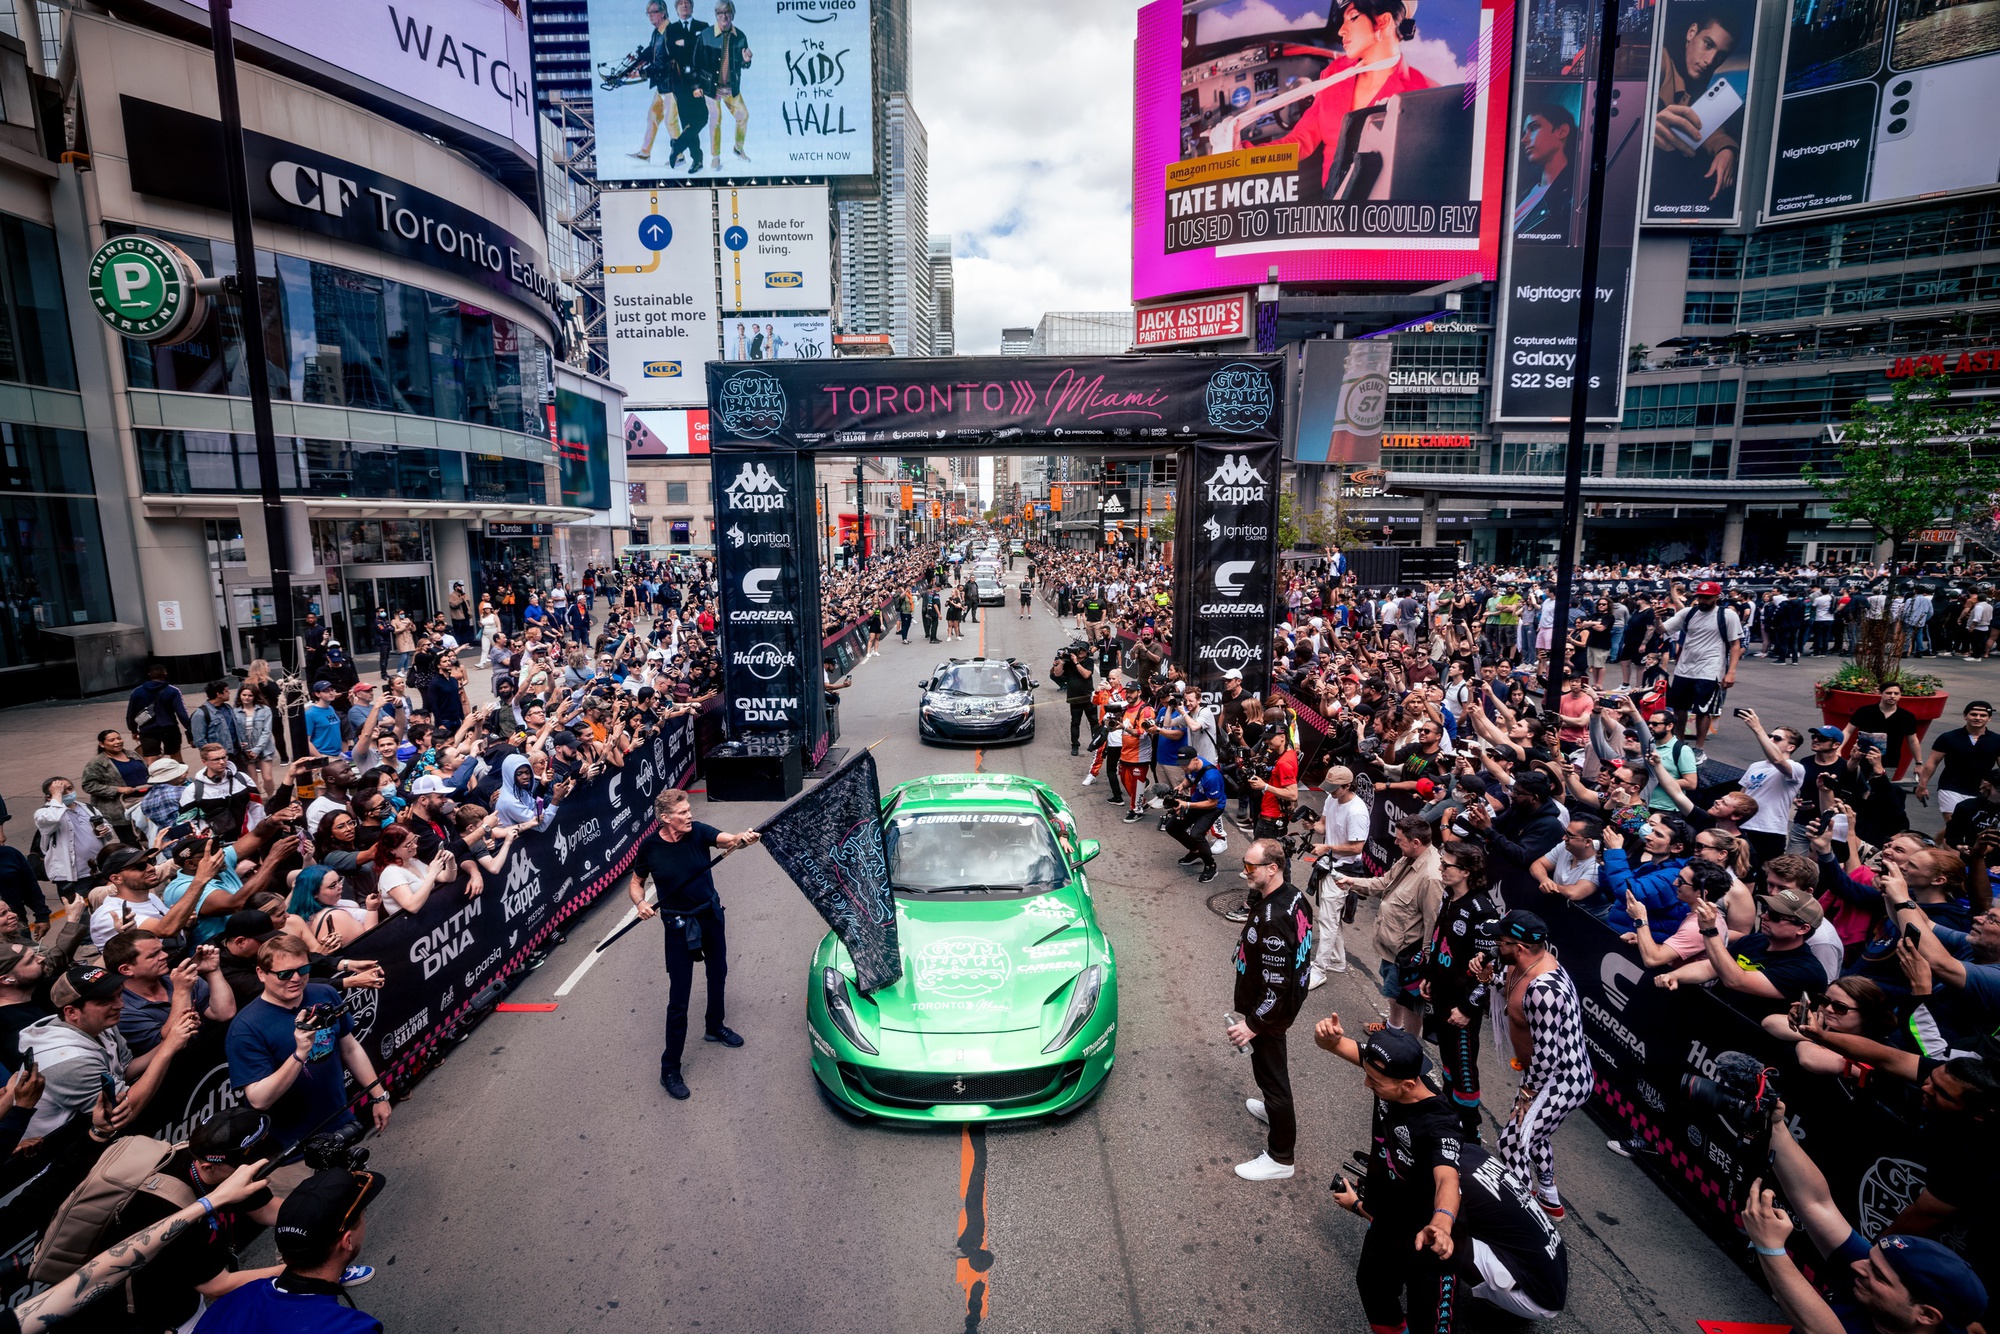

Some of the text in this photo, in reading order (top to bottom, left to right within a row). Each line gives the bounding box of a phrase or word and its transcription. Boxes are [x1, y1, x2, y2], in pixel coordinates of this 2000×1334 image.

[777, 0, 856, 14] prime video
[801, 38, 825, 51] the
[388, 5, 530, 117] WATCH
[785, 48, 850, 86] KIDS
[797, 86, 834, 99] in the
[782, 100, 856, 136] HALL
[789, 151, 851, 162] WATCH NOW
[1782, 138, 1860, 159] Nightography
[1170, 151, 1293, 182] amazon music NEW ALBUM
[269, 160, 358, 218] CF
[1169, 176, 1299, 218] TATE MCRAE
[1654, 204, 1679, 214] Galaxy
[1680, 204, 1692, 213] S22
[1776, 193, 1853, 212] Galaxy S22 Series
[758, 218, 805, 230] Made for
[1167, 206, 1478, 249] I USED TO THINK I COULD FLY
[369, 187, 503, 273] Toronto
[509, 246, 553, 301] Eaton
[758, 231, 814, 243] downtown
[1518, 233, 1562, 241] samsung.com
[758, 244, 791, 256] living.
[91, 242, 170, 278] MUNICIPAL
[114, 262, 151, 301] P
[768, 275, 800, 285] IKEA
[1915, 280, 1960, 297] DMZ
[613, 293, 694, 307] Sustainable
[1844, 286, 1886, 302] DMZ
[95, 292, 178, 331] PARKING
[614, 310, 707, 326] just got more
[1140, 302, 1241, 332] JACK ASTOR'S
[616, 325, 689, 339] attainable.
[1140, 322, 1221, 343] PARTY IS THIS WAY
[1514, 336, 1577, 347] Captured with
[794, 342, 825, 359] KIDS
[647, 364, 679, 375] IKEA
[1512, 351, 1576, 371] Galaxy
[1886, 354, 1948, 379] JACK
[723, 378, 780, 397] GUM
[1211, 370, 1269, 391] GUM
[1388, 372, 1479, 386] SHARK CLUB
[1510, 373, 1541, 388] S22
[1359, 382, 1384, 394] HEINZ
[723, 394, 782, 414] BALL
[824, 383, 1005, 415] TORONTO
[1045, 368, 1169, 426] Miami
[1212, 388, 1270, 408] BALL
[1358, 396, 1382, 413] 57
[694, 423, 710, 431] Get
[1640, 409, 1695, 428] DMZ
[902, 430, 929, 439] parsiq
[1382, 434, 1471, 448] LITTLE CANADA
[728, 492, 785, 513] Kappa
[1208, 485, 1265, 506] Kappa
[500, 524, 522, 533] Dundas
[1224, 524, 1268, 539] Ignition
[748, 532, 790, 545] Ignition
[730, 610, 794, 621] CARRERA
[1200, 604, 1265, 615] CARRERA
[733, 652, 795, 667] Hard Rock
[1200, 644, 1262, 661] Hard Rock
[735, 698, 798, 711] QNTM
[744, 710, 789, 722] DNA
[916, 814, 1018, 825] GUMBALL 3000
[568, 818, 601, 852] Ignition
[582, 830, 602, 846] CASINO
[800, 850, 841, 903] TORONTO
[502, 878, 542, 923] Kappa
[527, 905, 545, 925] PISTON
[1025, 907, 1075, 920] Kappa
[410, 896, 482, 964] QNTM
[423, 928, 475, 981] DNA
[924, 942, 1004, 957] GUM
[1022, 942, 1078, 953] QNTM
[1030, 950, 1070, 959] DNA
[474, 946, 502, 980] parsiq
[1017, 962, 1082, 972] CARRERA
[1262, 954, 1286, 963] PISTON
[910, 1002, 966, 1011] TORONTO
[394, 1006, 428, 1037] LUCKY BASTARD
[1582, 996, 1646, 1059] CARRERA
[395, 1016, 429, 1049] SALOON
[1372, 1044, 1392, 1063] GUMBALL
[278, 1227, 308, 1237] GUMBALL
